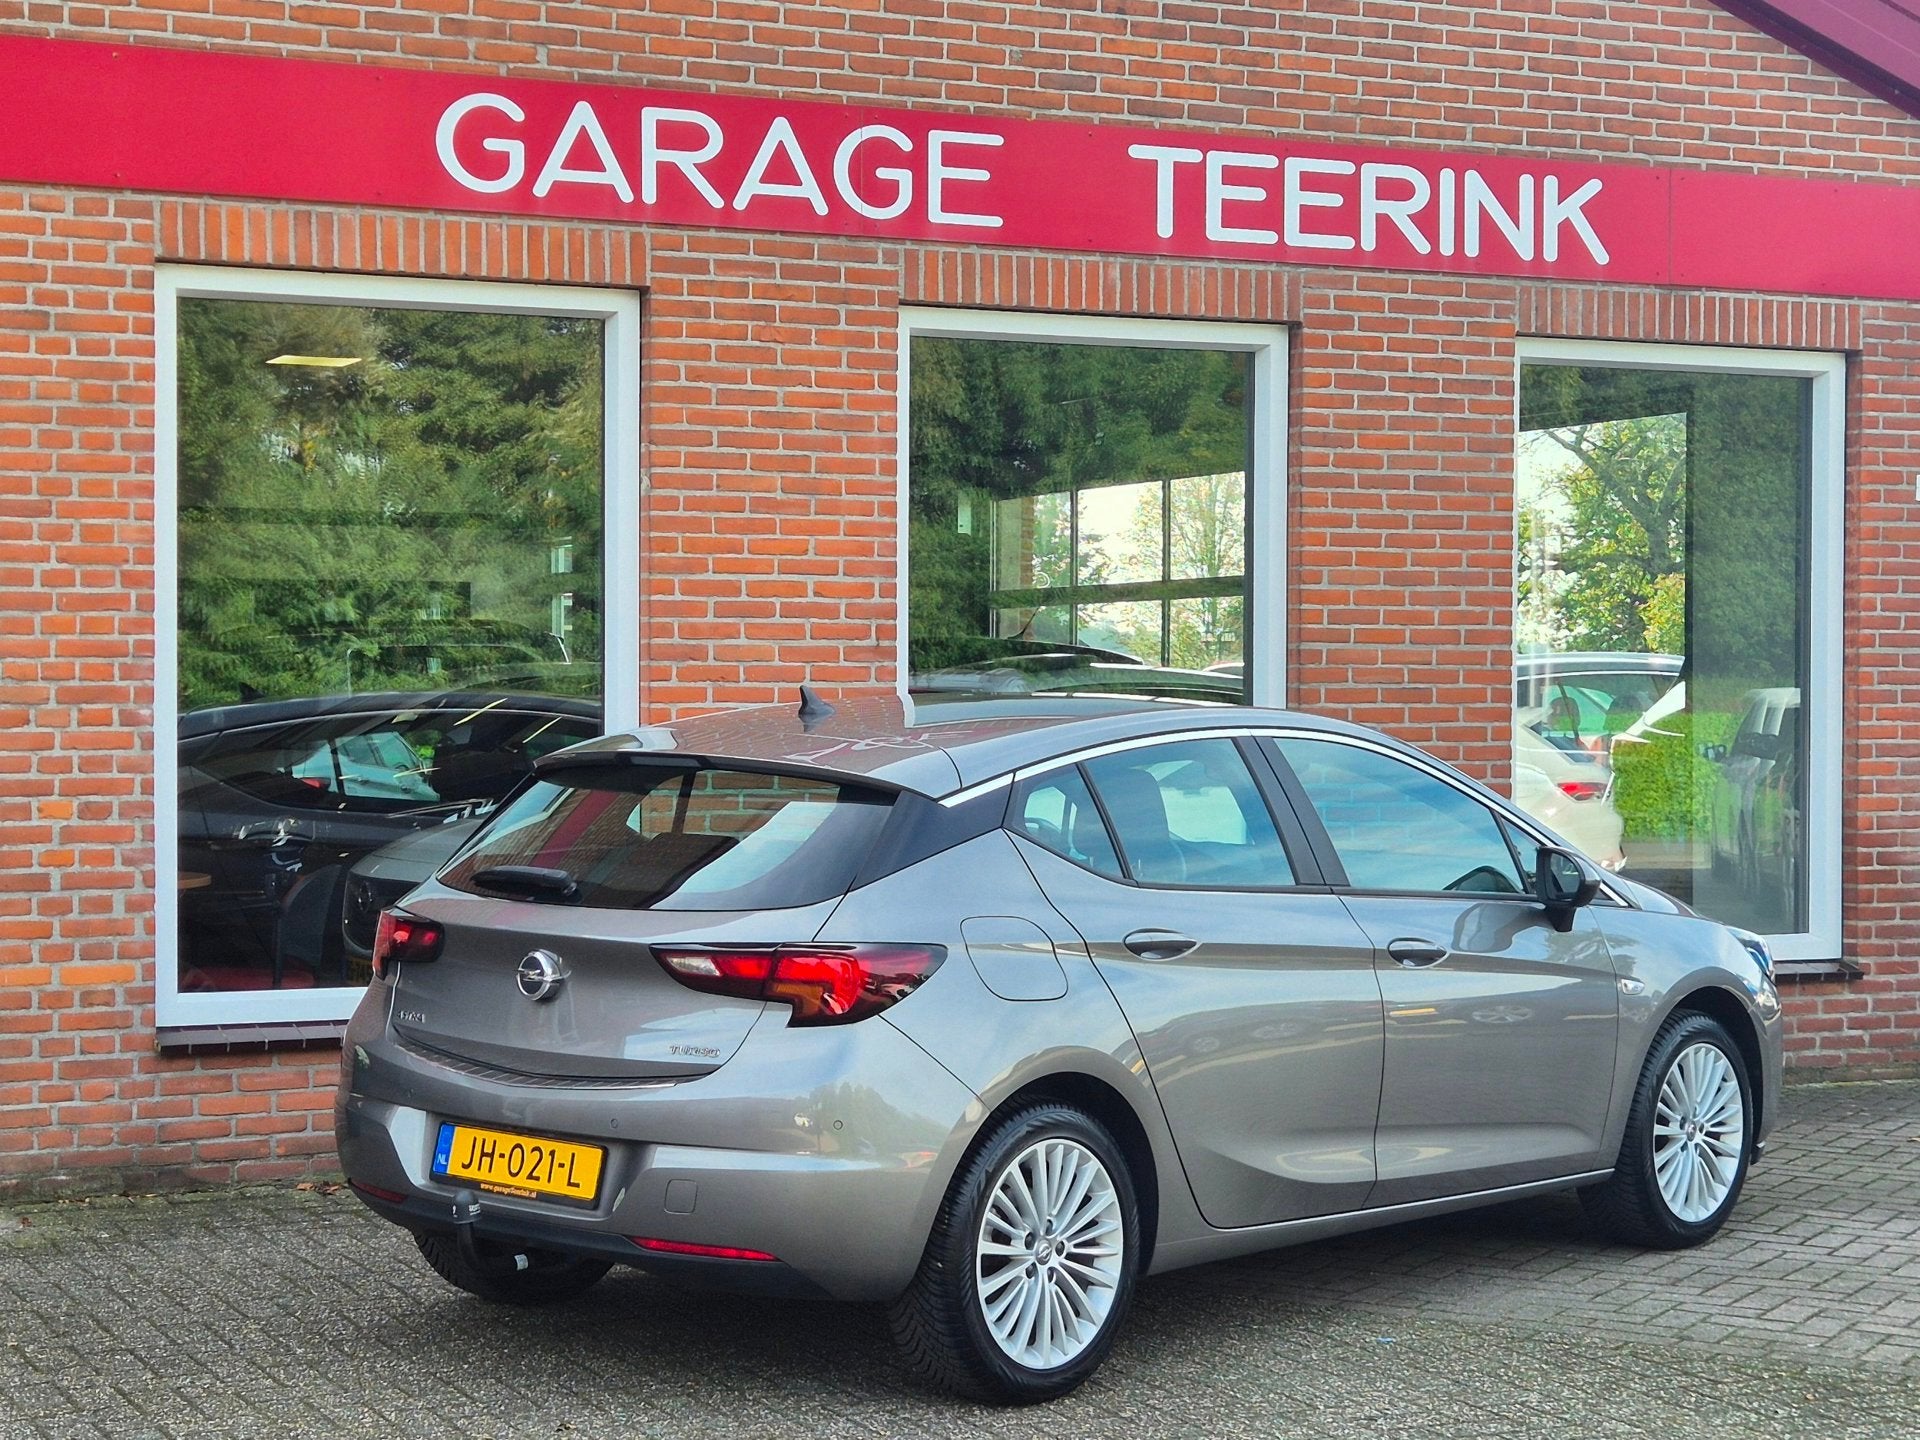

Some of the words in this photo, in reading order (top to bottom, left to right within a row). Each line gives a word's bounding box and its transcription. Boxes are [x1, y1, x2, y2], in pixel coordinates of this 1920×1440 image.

[436, 93, 1004, 227] GARAGE
[1128, 144, 1610, 265] TEERINK
[669, 1045, 720, 1058] TURBO
[436, 1153, 448, 1165] NL
[461, 1136, 581, 1188] JH-021-L
